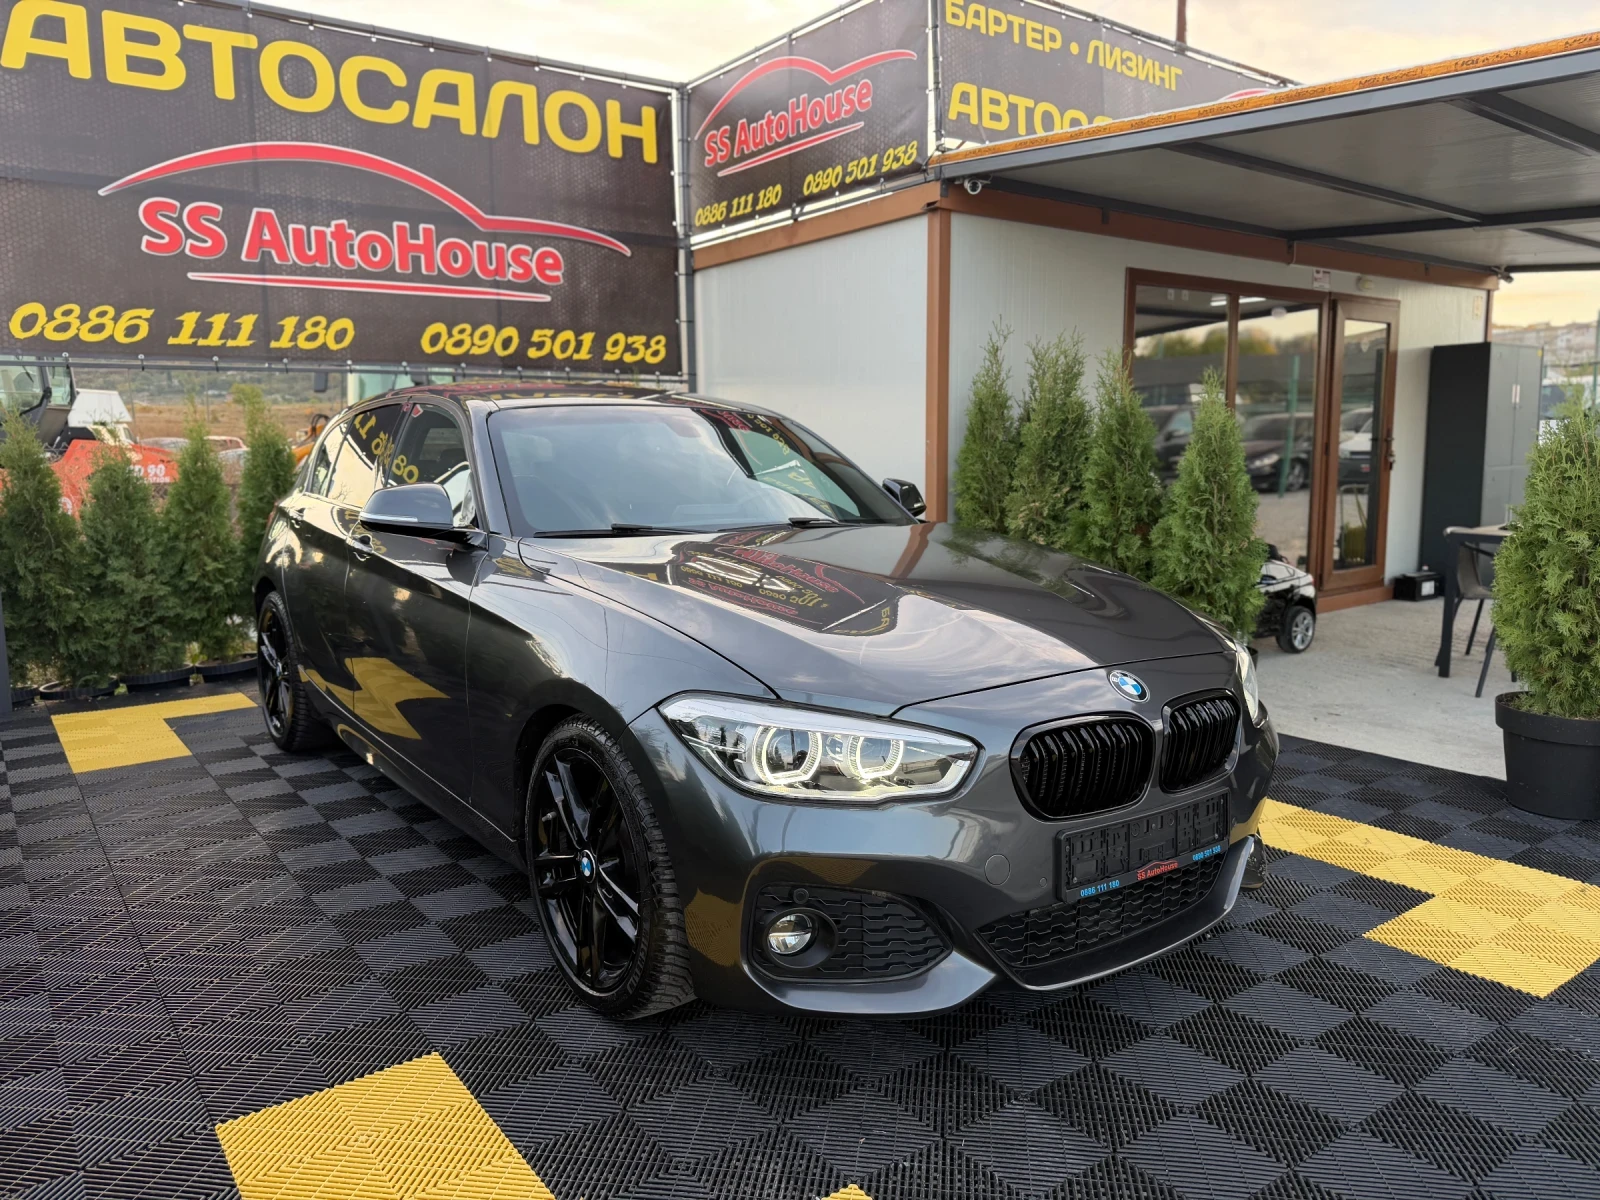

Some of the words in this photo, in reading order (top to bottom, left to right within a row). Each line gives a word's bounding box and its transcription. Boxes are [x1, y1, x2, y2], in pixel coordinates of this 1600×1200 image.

[945, 0, 1063, 52] БАРТЕР
[1086, 39, 1182, 91] ЛИЗИНГ
[0, 0, 658, 164] АВТОСАЛОН
[704, 125, 730, 167] SS
[733, 79, 872, 158] AutoHouse
[802, 165, 843, 196] 0890
[845, 154, 878, 185] 501
[881, 141, 918, 173] 938
[695, 200, 728, 228] 0886
[729, 192, 754, 218] 111
[756, 184, 782, 211] 180
[138, 197, 228, 260] SS
[241, 206, 564, 285] AutoHouse
[8, 301, 154, 344] 0886
[167, 310, 258, 348] 111
[269, 315, 356, 351] 180
[420, 322, 518, 357] 0890
[527, 328, 594, 360] 501
[603, 332, 667, 364] 938
[147, 463, 165, 478] 90
[1097, 883, 1107, 892] 111
[1137, 871, 1146, 881] SS
[1147, 862, 1178, 878] AutoHouse
